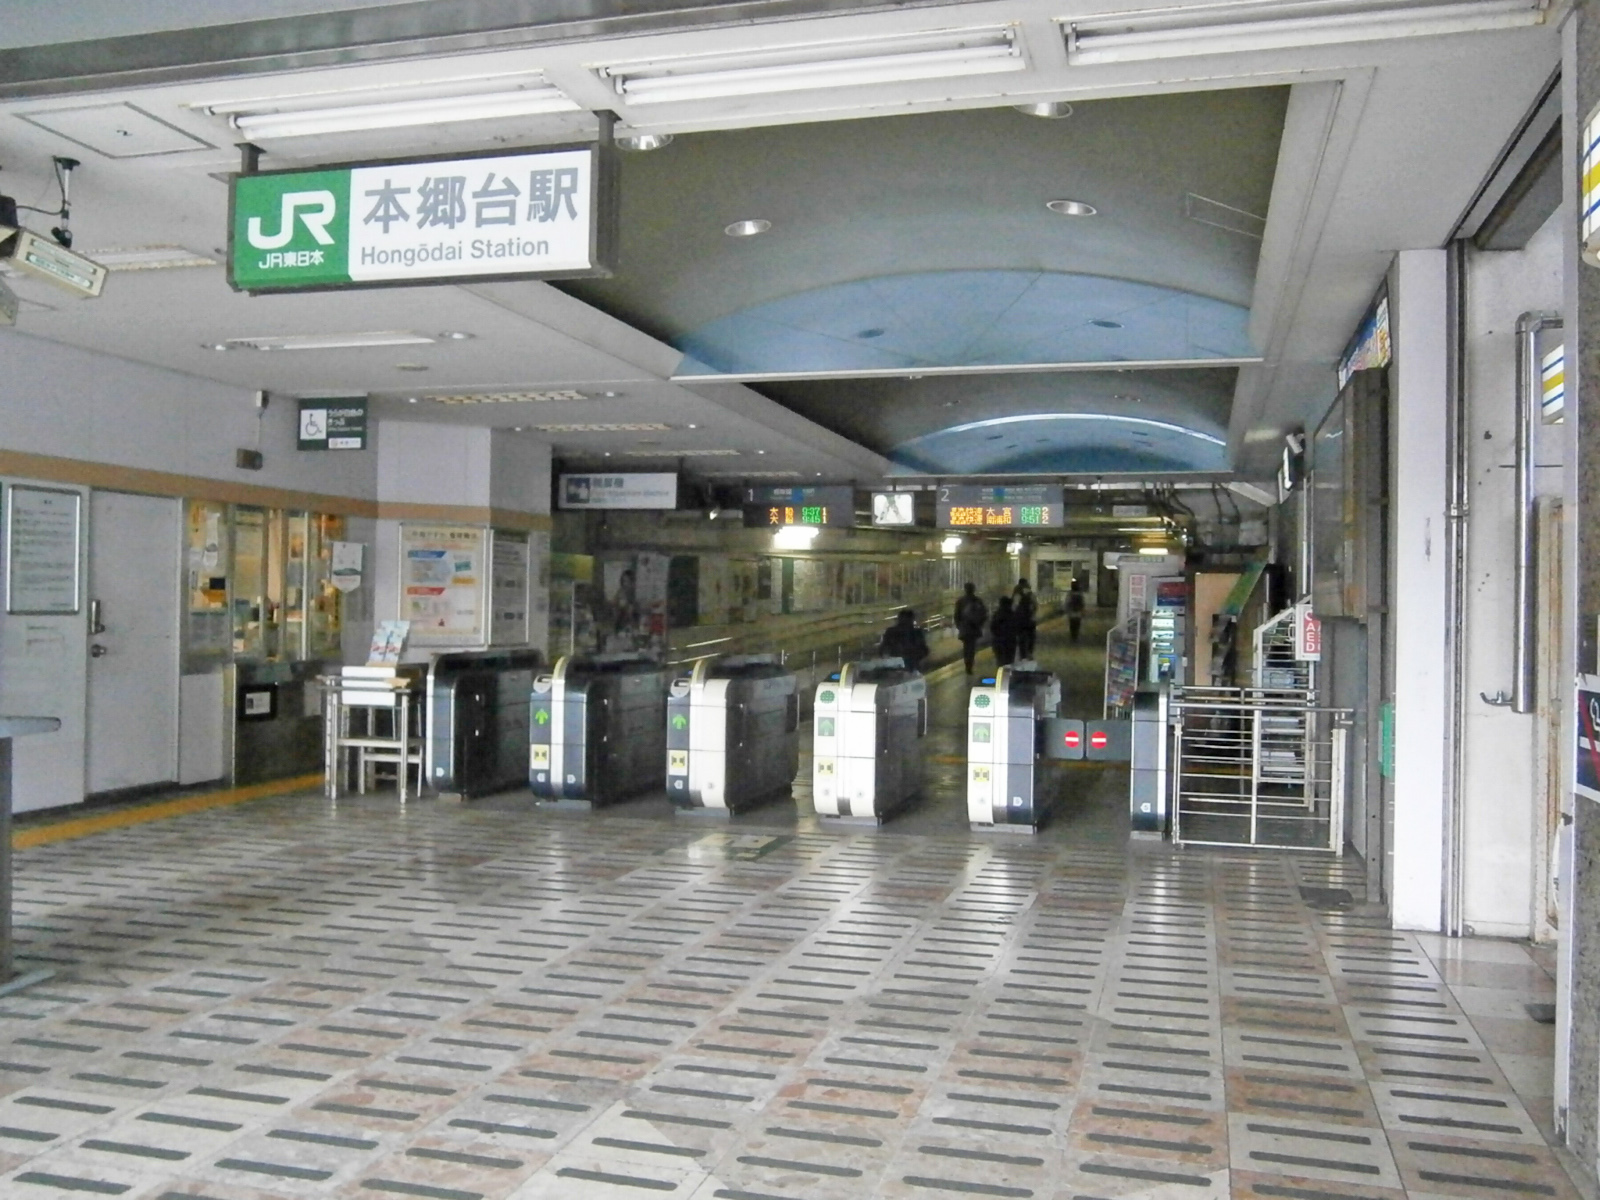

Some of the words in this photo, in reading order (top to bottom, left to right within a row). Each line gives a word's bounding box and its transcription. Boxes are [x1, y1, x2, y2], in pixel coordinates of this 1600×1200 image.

[363, 167, 579, 235] 本郷台駅
[247, 190, 336, 250] JR
[258, 249, 325, 269] JR東日本
[361, 242, 463, 268] Hongōdai
[470, 237, 550, 260] Station
[748, 488, 754, 502] 1
[940, 488, 950, 502] 2
[1305, 622, 1316, 652] AED
